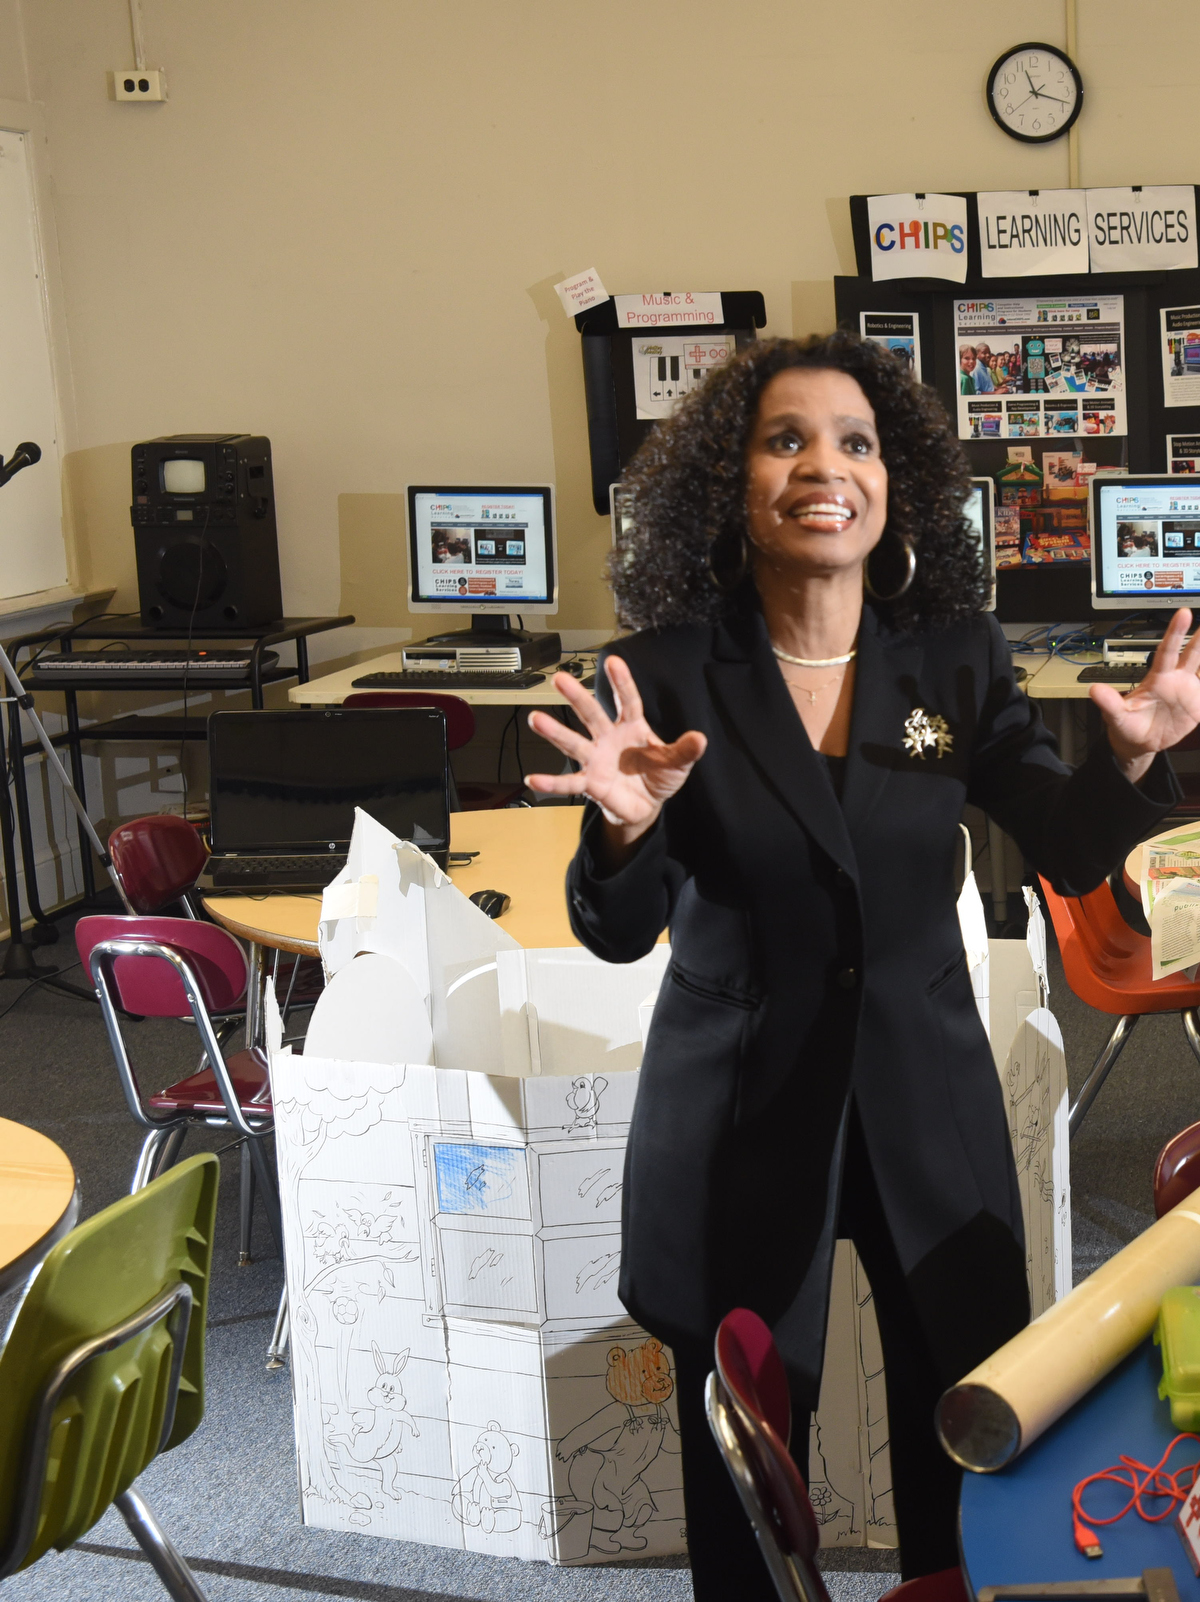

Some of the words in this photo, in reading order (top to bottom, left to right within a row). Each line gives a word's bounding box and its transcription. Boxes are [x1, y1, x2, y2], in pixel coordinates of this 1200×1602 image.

[1029, 56, 1038, 68] 12
[1004, 72, 1016, 84] 10
[1057, 71, 1065, 83] 2
[1000, 88, 1009, 99] 9
[1063, 86, 1070, 98] 3
[1005, 103, 1014, 115] 8
[1019, 114, 1024, 126] 7
[1032, 118, 1041, 130] 6
[1048, 113, 1055, 124] 5
[874, 220, 964, 254] CHIPS
[986, 212, 1082, 249] LEARNING
[1094, 210, 1188, 246] SERVICES
[564, 278, 587, 293] Program
[571, 288, 583, 300] Play
[642, 294, 681, 306] Music
[685, 292, 695, 304] &
[578, 296, 595, 307] Piano
[958, 302, 994, 313] CHIPS
[627, 310, 714, 325] Programming
